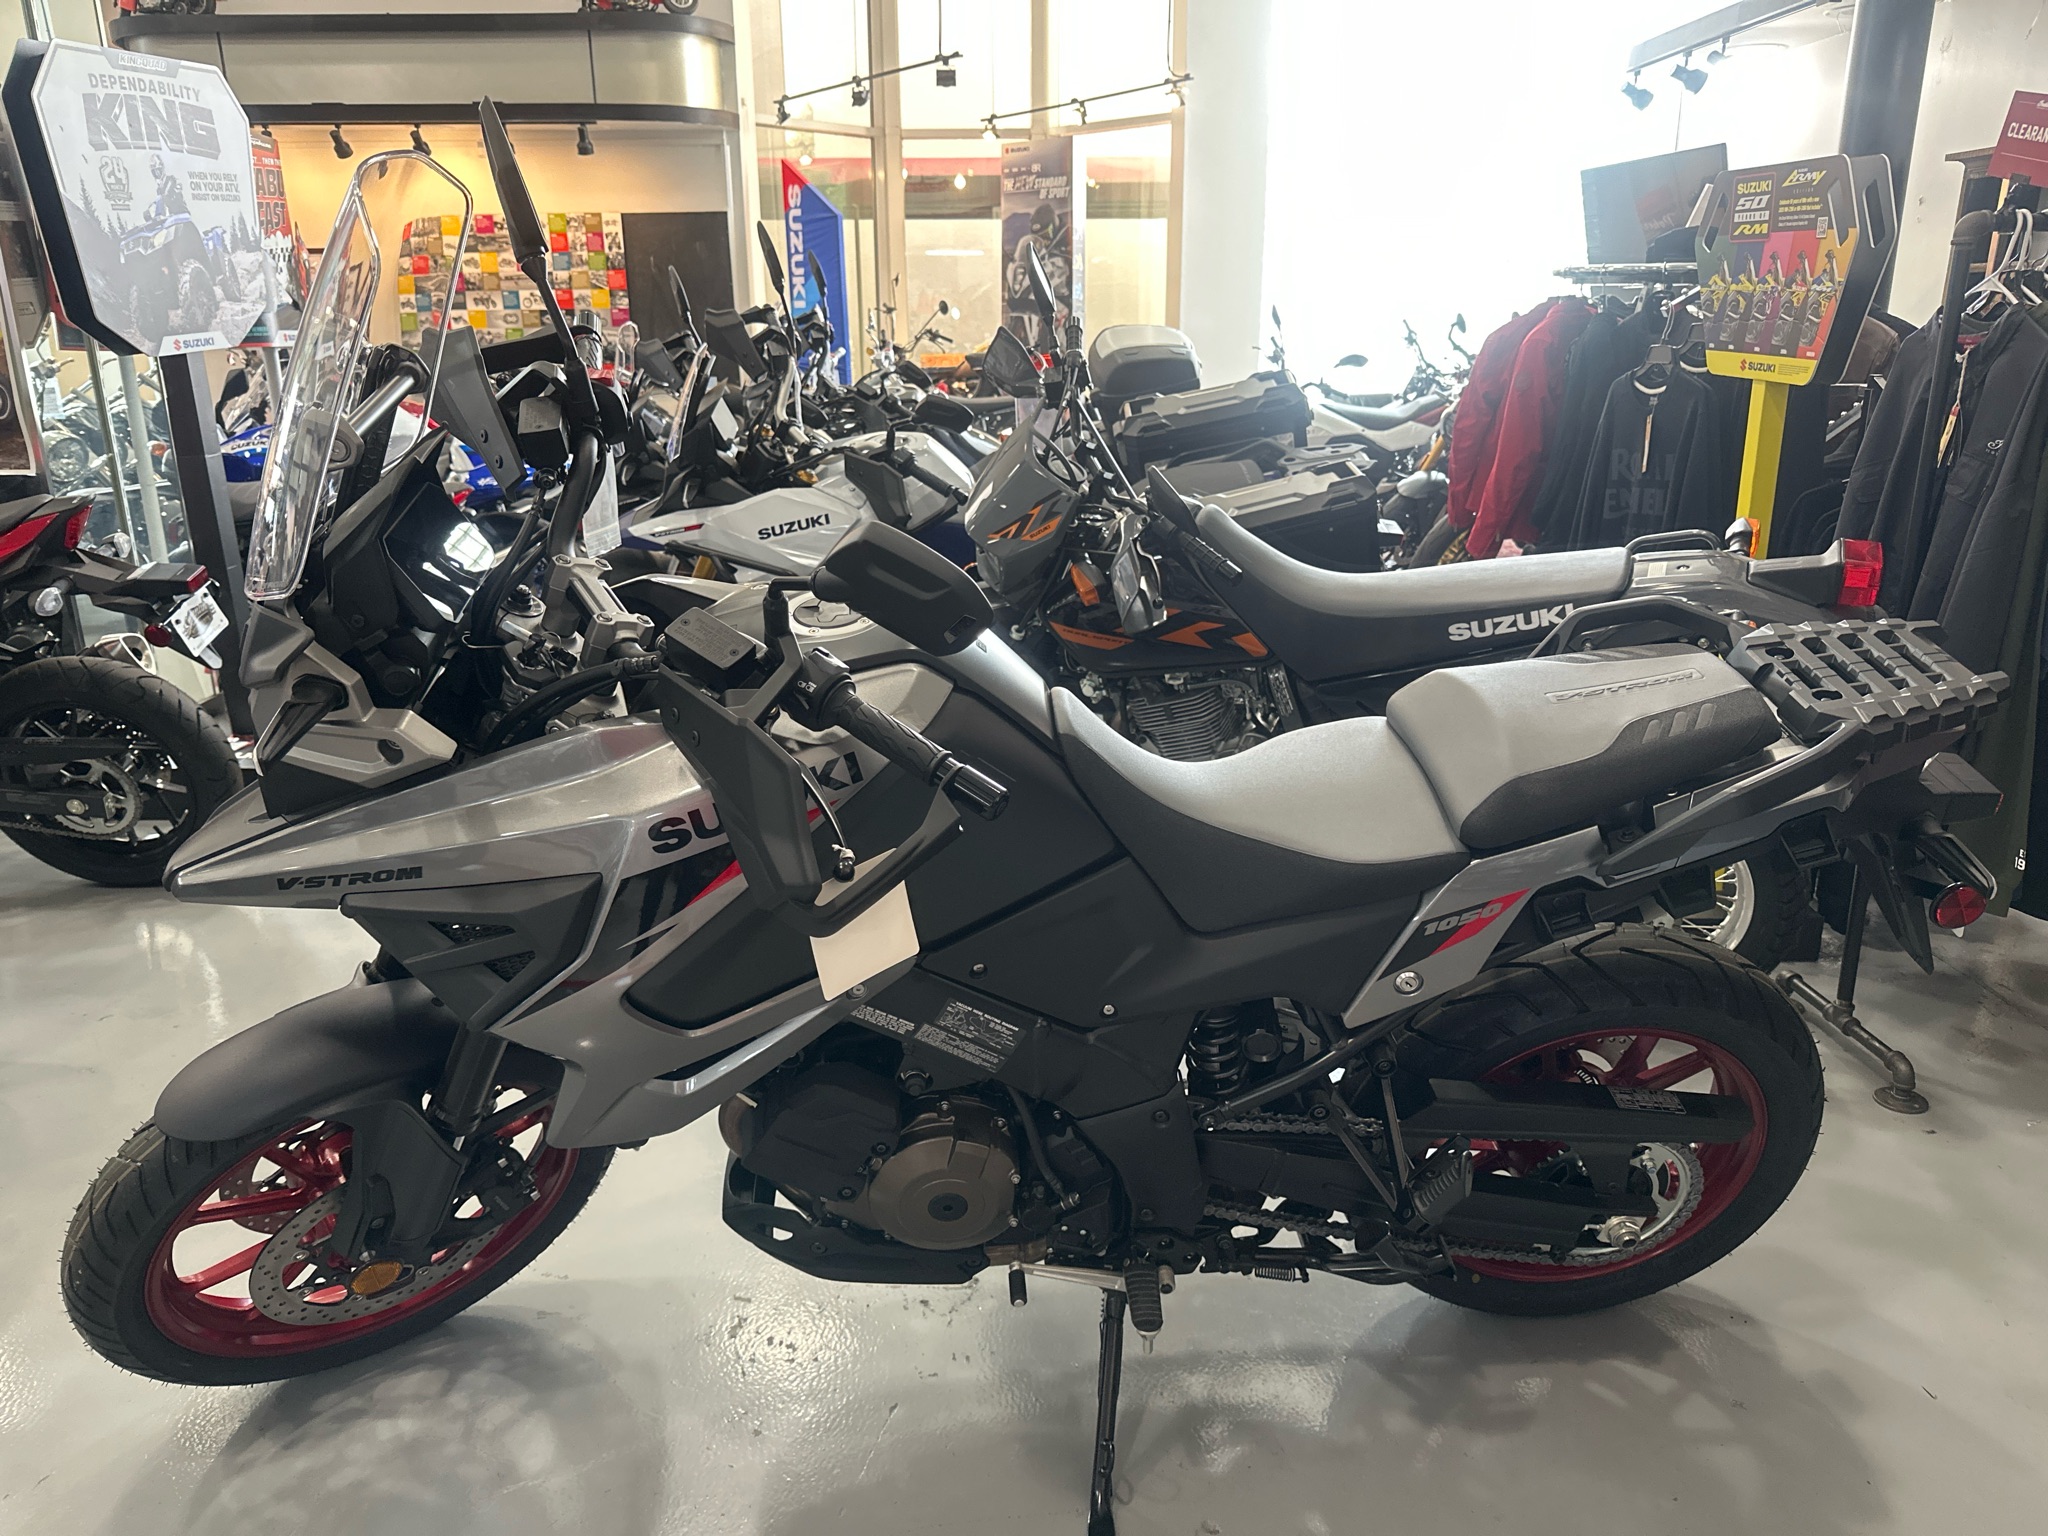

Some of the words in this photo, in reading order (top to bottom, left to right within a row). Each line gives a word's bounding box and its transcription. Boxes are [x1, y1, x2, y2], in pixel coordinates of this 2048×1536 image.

[87, 73, 200, 102] DEPENDABILITY
[82, 92, 221, 160] KING
[2007, 122, 2048, 143] CLEARAN
[187, 171, 208, 181] WHEN
[209, 172, 222, 181] YOU
[223, 173, 237, 182] RELY
[1034, 176, 1068, 189] STANDARD
[190, 181, 203, 191] ON
[205, 182, 224, 192] YOUR
[1048, 187, 1070, 199] SPORT
[1737, 180, 1772, 194] SUZUKI
[212, 194, 220, 202] ON
[1735, 194, 1771, 211] 50
[1733, 223, 1769, 236] RM
[787, 184, 806, 309] SUZUKI
[183, 337, 215, 349] SUZUKI
[1747, 362, 1776, 373] SUZUKI
[230, 440, 268, 451] SUZUK
[757, 513, 830, 540] SUZUKI
[1448, 603, 1574, 642] SUZUKI
[647, 751, 864, 854] SUKI
[276, 866, 423, 891] V-STROM
[1423, 902, 1504, 936] 1050
[984, 1013, 1002, 1024] ROUTING
[1001, 1021, 1019, 1032] DIAGRAM
